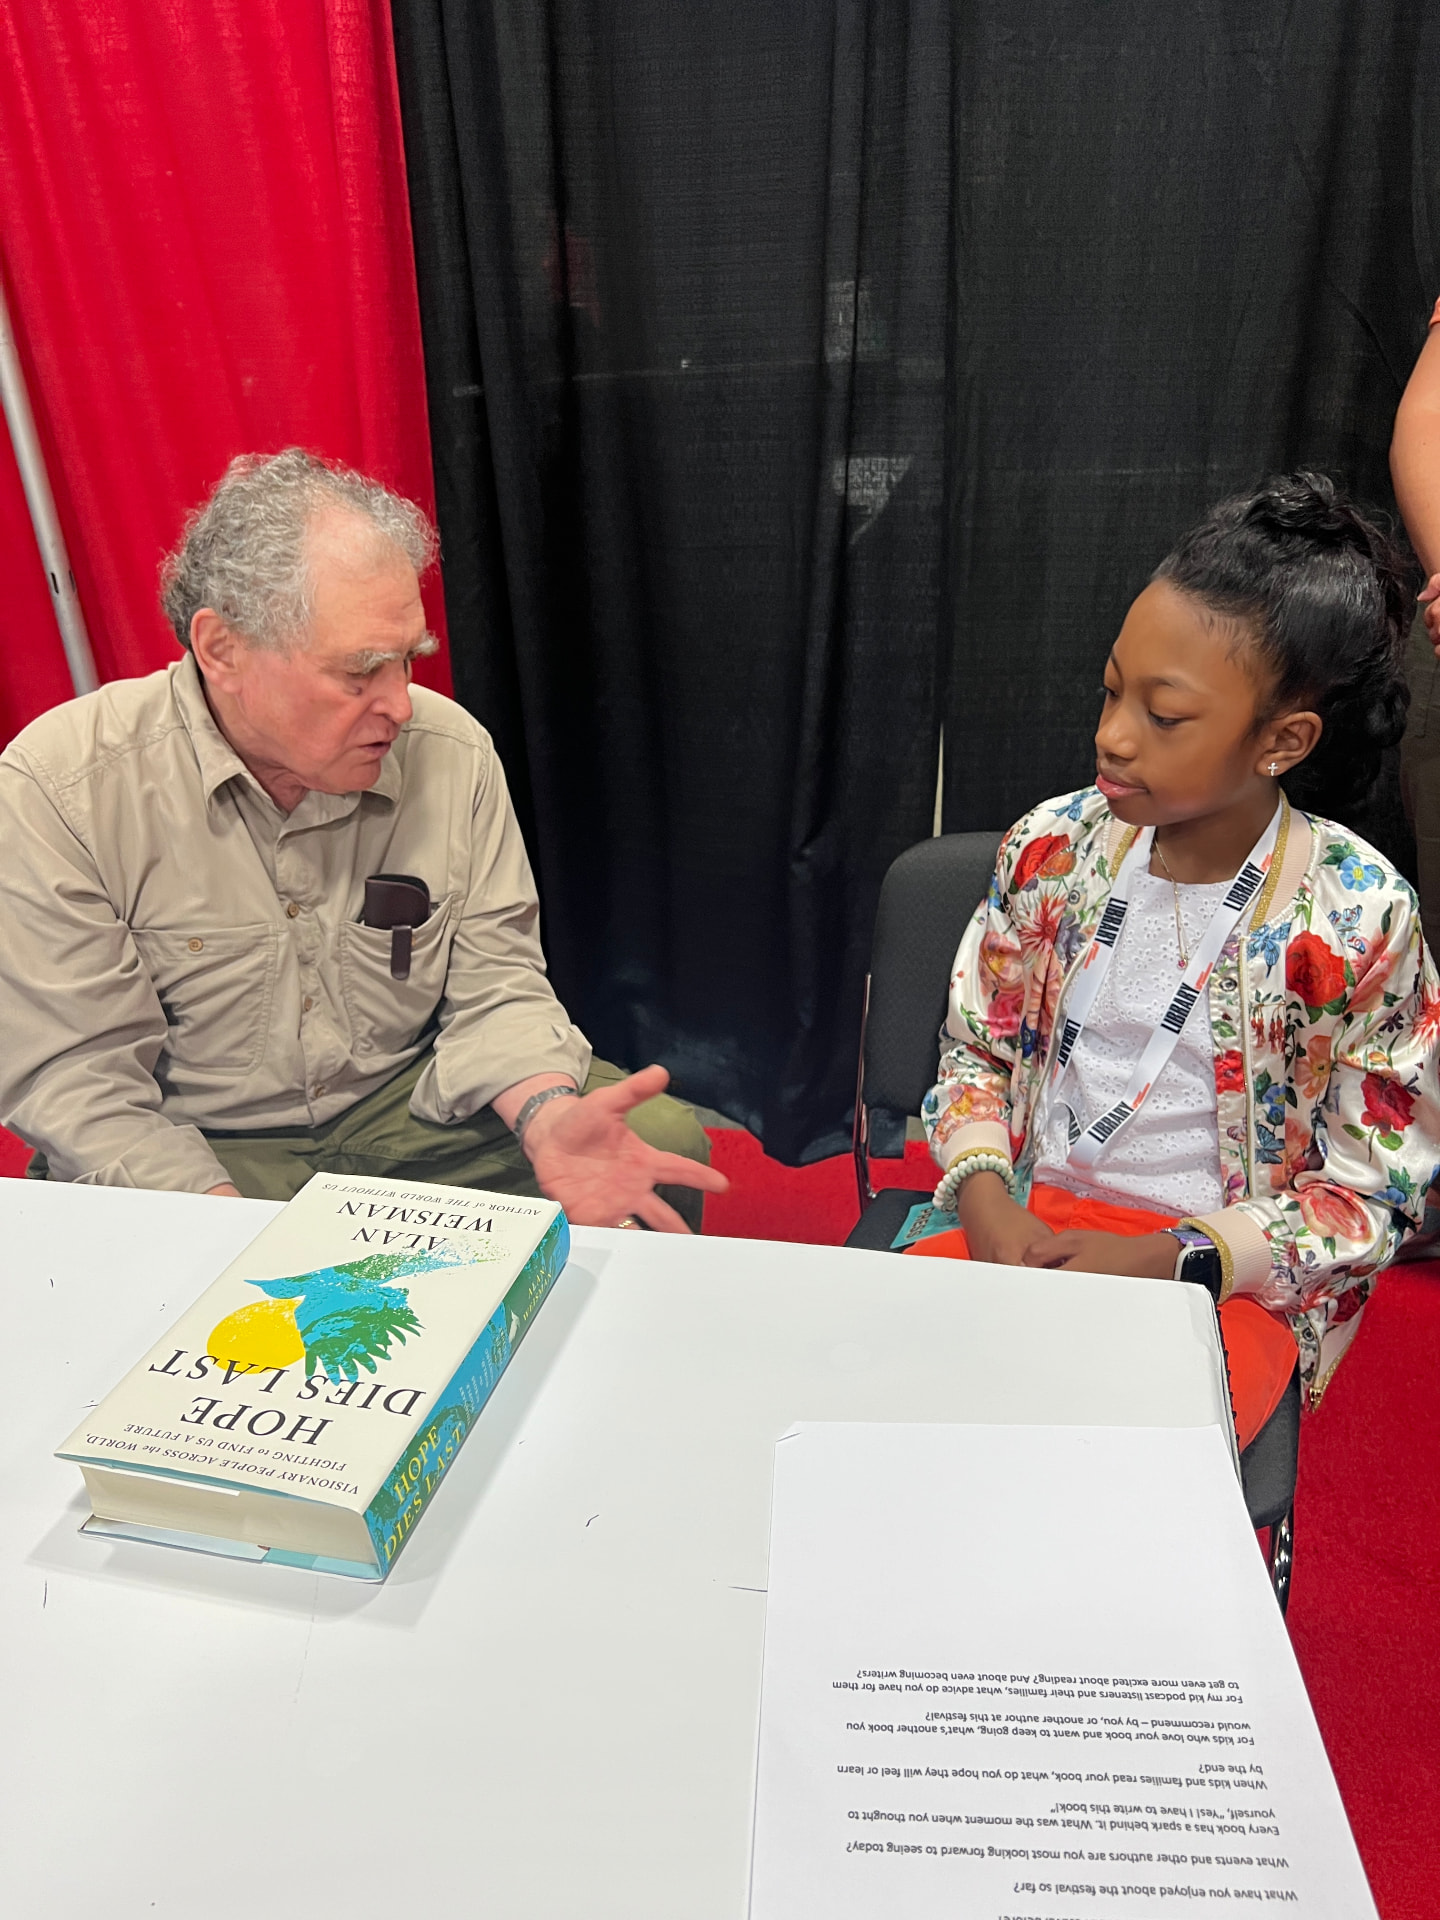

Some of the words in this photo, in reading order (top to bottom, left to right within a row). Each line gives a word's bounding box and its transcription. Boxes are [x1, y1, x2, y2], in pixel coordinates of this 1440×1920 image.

[1222, 861, 1266, 912] LIBRARY
[1094, 898, 1128, 948] LIBRARY
[1160, 982, 1200, 1035] LIBRARY
[1058, 1018, 1081, 1068] LIBRARY
[1088, 1100, 1134, 1144] LIBRARY
[322, 1183, 337, 1191] US
[339, 1186, 397, 1198] WITHOUT
[400, 1192, 441, 1203] WORLD
[445, 1198, 470, 1207] THE
[489, 1204, 542, 1216] AUTHOR
[336, 1200, 494, 1233] WEISMAN
[350, 1227, 450, 1251] ALAN
[529, 1270, 545, 1299] ALAN
[148, 1349, 290, 1394] LAST
[296, 1375, 427, 1417] DIES
[180, 1396, 334, 1446] HOPE
[123, 1423, 181, 1441] FUTURE
[86, 1433, 138, 1451] WORLD,
[184, 1433, 195, 1443] A
[196, 1436, 214, 1447] US
[142, 1444, 161, 1454] the
[218, 1440, 257, 1455] FIND
[162, 1448, 219, 1465] ACROSS
[272, 1451, 348, 1472] FIGHTING
[219, 1458, 274, 1478] PEOPLE
[394, 1425, 441, 1504] HOPE
[277, 1470, 360, 1495] VISIONARY
[384, 1492, 422, 1562] DIES
[425, 1422, 462, 1495] LAST
[857, 1670, 897, 1680] writers?
[899, 1669, 948, 1682] becoming
[978, 1674, 1007, 1683] about
[1010, 1675, 1030, 1684] And
[1033, 1674, 1076, 1685] reading?
[832, 1681, 859, 1691] them
[1079, 1677, 1109, 1686] about
[1112, 1678, 1148, 1688] excited
[1181, 1680, 1206, 1688] even
[1208, 1680, 1225, 1689] get
[1228, 1682, 1239, 1690] to
[861, 1683, 876, 1692] for
[878, 1684, 902, 1693] have
[904, 1683, 924, 1692] you
[926, 1685, 940, 1694] do
[942, 1686, 974, 1695] advice
[976, 1686, 1003, 1696] what
[1004, 1686, 1048, 1698] families,
[1049, 1689, 1075, 1698] their
[1077, 1690, 1097, 1699] and
[1098, 1691, 1143, 1701] listeners
[1144, 1692, 1186, 1702] podcast
[1207, 1692, 1223, 1702] my
[1188, 1694, 1205, 1704] kid
[1225, 1695, 1244, 1704] For
[926, 1712, 967, 1722] festival?
[970, 1713, 989, 1723] this
[991, 1714, 1002, 1722] at
[1005, 1714, 1039, 1724] author
[1042, 1716, 1084, 1725] another
[1100, 1716, 1124, 1726] you,
[846, 1721, 866, 1730] you
[1126, 1717, 1139, 1728] by
[1151, 1720, 1214, 1729] recommend
[1218, 1722, 1251, 1732] would
[868, 1724, 894, 1734] book
[896, 1724, 938, 1734] another
[977, 1725, 1009, 1736] going,
[1012, 1726, 1037, 1738] keep
[1039, 1729, 1051, 1738] to
[1053, 1730, 1080, 1738] want
[1082, 1731, 1102, 1740] and
[1105, 1732, 1132, 1742] book
[1135, 1731, 1160, 1740] your
[1162, 1733, 1184, 1744] love
[1186, 1734, 1210, 1744] who
[1212, 1736, 1234, 1746] kids
[1237, 1736, 1254, 1746] For
[837, 1765, 864, 1776] learn
[866, 1766, 879, 1774] or
[881, 1768, 901, 1778] feel
[904, 1768, 923, 1778] will
[924, 1766, 950, 1779] they
[952, 1768, 979, 1780] hope
[982, 1769, 1002, 1778] you
[1198, 1764, 1225, 1774] end?
[1228, 1765, 1247, 1775] the
[1249, 1763, 1264, 1776] by
[1004, 1771, 1019, 1781] do
[1020, 1771, 1050, 1782] what
[1051, 1771, 1082, 1783] book,
[1084, 1772, 1110, 1782] your
[1112, 1774, 1138, 1784] read
[1139, 1776, 1183, 1788] families
[1185, 1778, 1206, 1788] and
[1208, 1778, 1231, 1790] kids
[1233, 1780, 1268, 1790] When
[1089, 1804, 1111, 1814] this
[1113, 1804, 1143, 1815] write
[1144, 1806, 1158, 1815] to
[1160, 1806, 1188, 1818] have
[1189, 1808, 1194, 1818] I
[1226, 1808, 1276, 1820] yourself,
[848, 1810, 860, 1820] to
[862, 1810, 906, 1824] thought
[908, 1812, 929, 1822] you
[931, 1814, 963, 1825] when
[964, 1816, 1012, 1825] moment
[1015, 1817, 1034, 1828] the
[1036, 1818, 1059, 1826] was
[1060, 1818, 1093, 1830] What
[1095, 1820, 1107, 1831] it.
[1109, 1820, 1149, 1832] behind
[1150, 1820, 1182, 1832] spark
[1184, 1824, 1192, 1832] a
[1194, 1824, 1214, 1835] has
[1216, 1824, 1246, 1836] book
[1248, 1823, 1280, 1836] Every
[846, 1840, 884, 1853] today?
[886, 1842, 923, 1855] seeing
[925, 1846, 938, 1856] to
[940, 1846, 985, 1859] forward
[987, 1846, 1030, 1860] looking
[1031, 1850, 1061, 1860] most
[1063, 1849, 1086, 1860] you
[1088, 1852, 1106, 1861] are
[1108, 1852, 1153, 1864] authors
[1156, 1854, 1188, 1865] other
[1190, 1855, 1212, 1866] and
[1214, 1856, 1254, 1866] events
[1256, 1857, 1290, 1868] What
[1013, 1882, 1036, 1894] far?
[1038, 1882, 1052, 1892] so
[1055, 1884, 1096, 1896] festival
[1099, 1885, 1119, 1897] the
[1120, 1886, 1156, 1897] about
[1159, 1885, 1206, 1899] enjoyed
[1208, 1887, 1232, 1898] you
[1233, 1889, 1262, 1901] have
[1264, 1890, 1298, 1901] What
